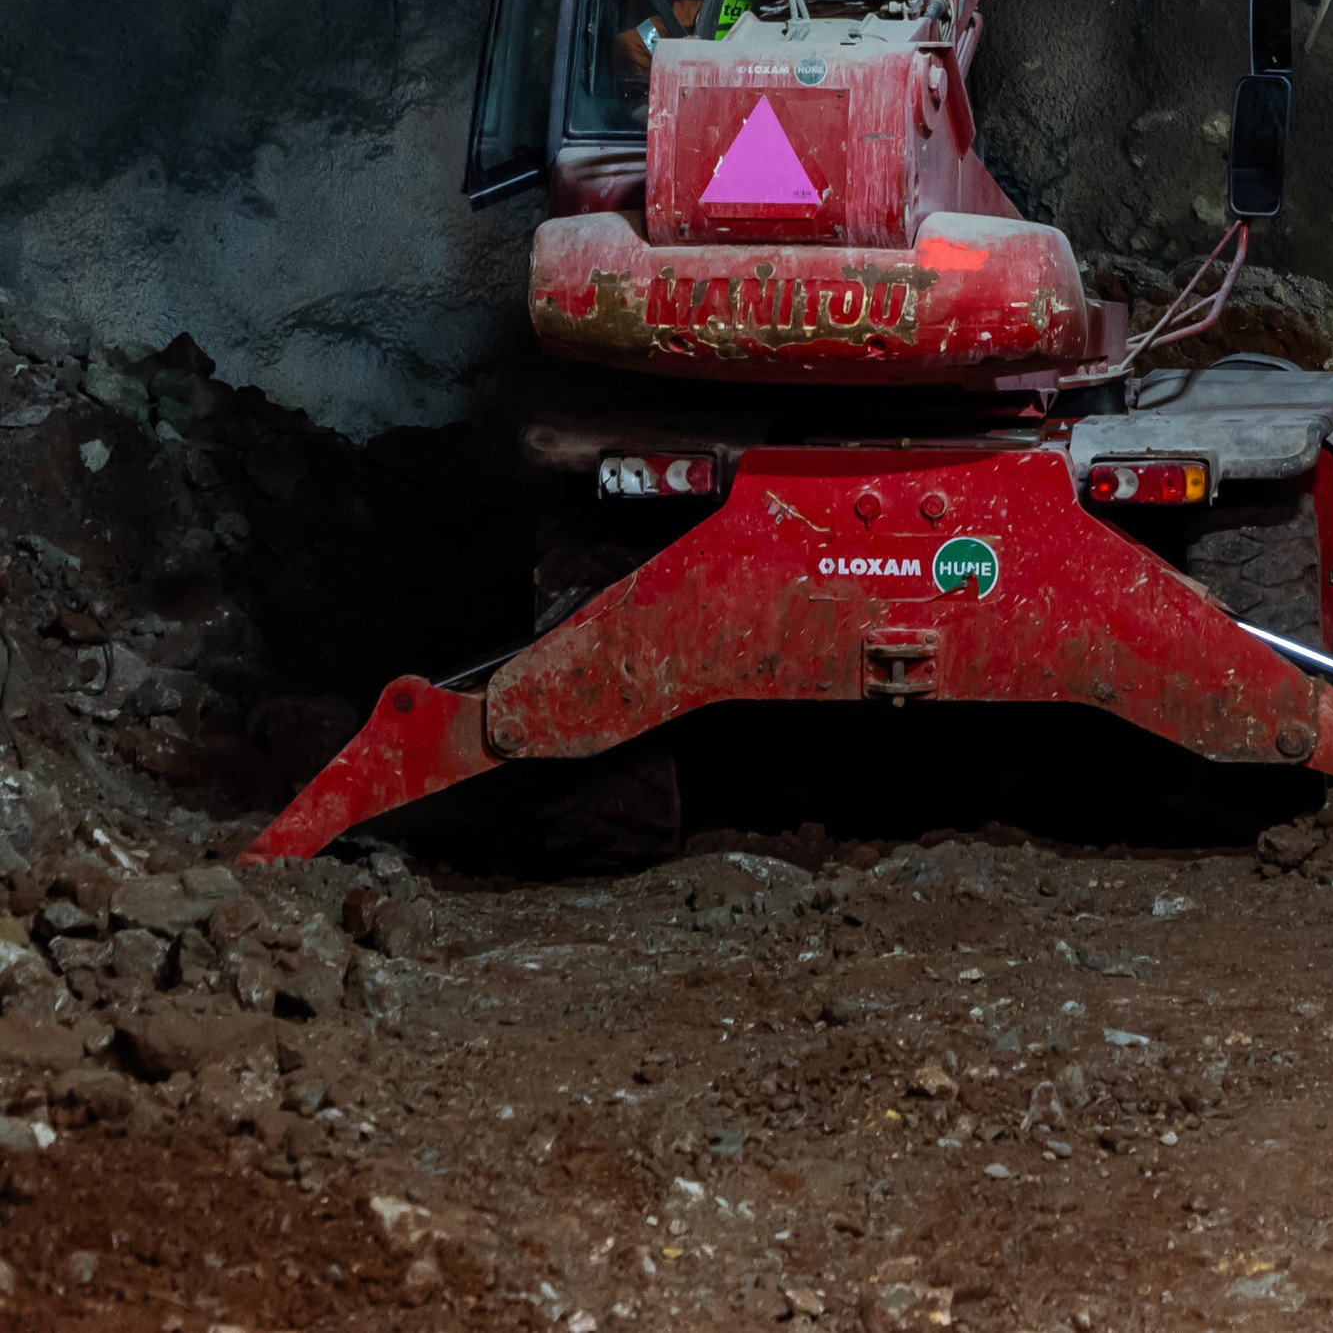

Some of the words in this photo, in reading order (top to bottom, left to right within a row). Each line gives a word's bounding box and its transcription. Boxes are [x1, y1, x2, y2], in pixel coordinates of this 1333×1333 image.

[747, 65, 790, 75] LOXAM
[797, 66, 825, 74] HUNE
[645, 277, 907, 328] MANITOU
[837, 558, 922, 576] LOXAM
[939, 561, 992, 576] HUNE
